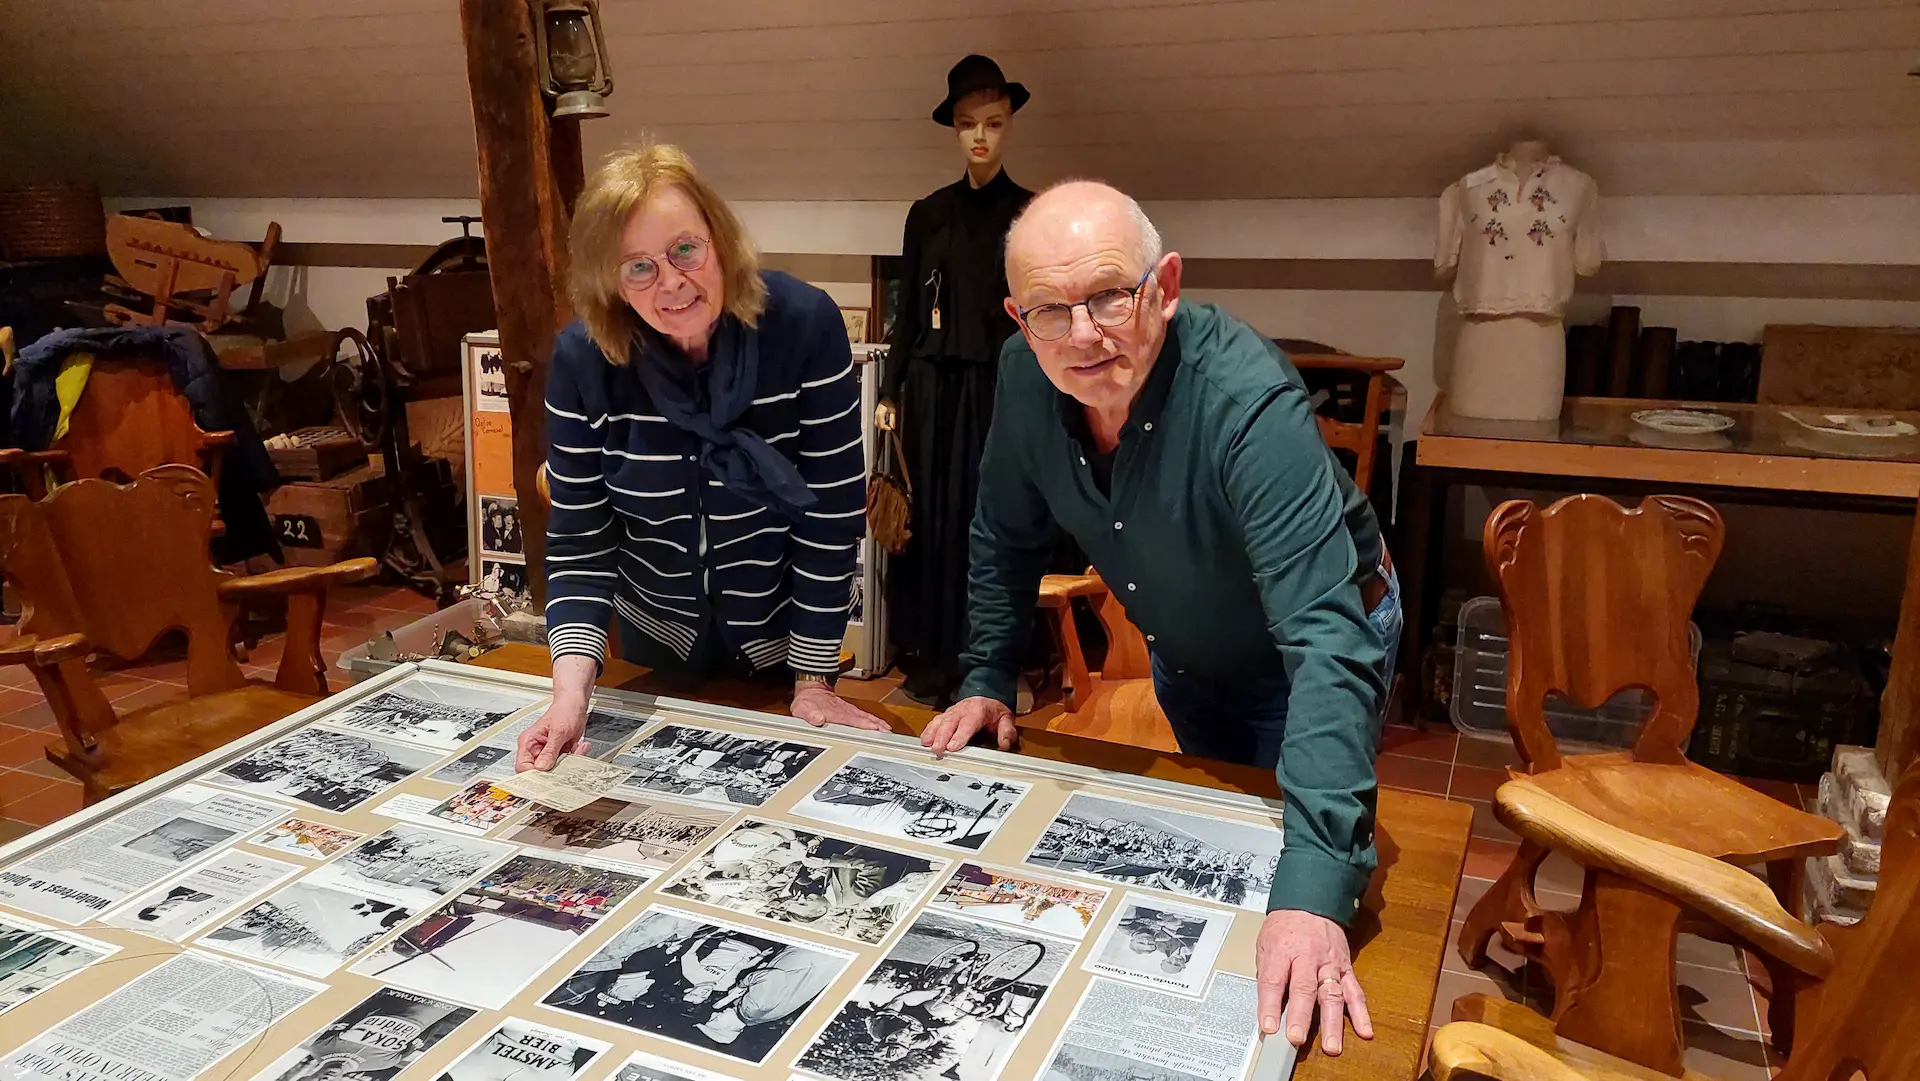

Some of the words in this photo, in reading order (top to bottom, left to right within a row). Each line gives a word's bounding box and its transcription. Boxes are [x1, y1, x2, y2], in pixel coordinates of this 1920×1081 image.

[283, 519, 309, 541] 22
[28, 880, 46, 890] te
[41, 884, 112, 910] Wielerfeest
[1094, 963, 1127, 975] Oploo
[1129, 972, 1150, 980] van
[1152, 976, 1190, 989] Ronde
[360, 1030, 407, 1050] SOKA
[519, 1034, 563, 1054] BIER
[1133, 1042, 1162, 1054] plaats
[44, 1042, 103, 1068] OPLOO
[492, 1042, 562, 1070] AMSTEL
[1119, 1047, 1131, 1055] de
[1133, 1052, 1169, 1066] bereikte
[1164, 1050, 1196, 1063] tweede
[14, 1052, 64, 1076] TOER
[99, 1060, 122, 1076] IN
[1173, 1061, 1211, 1077] Katwijk
[1199, 1060, 1228, 1072] fraaie
[116, 1065, 168, 1081] EER
